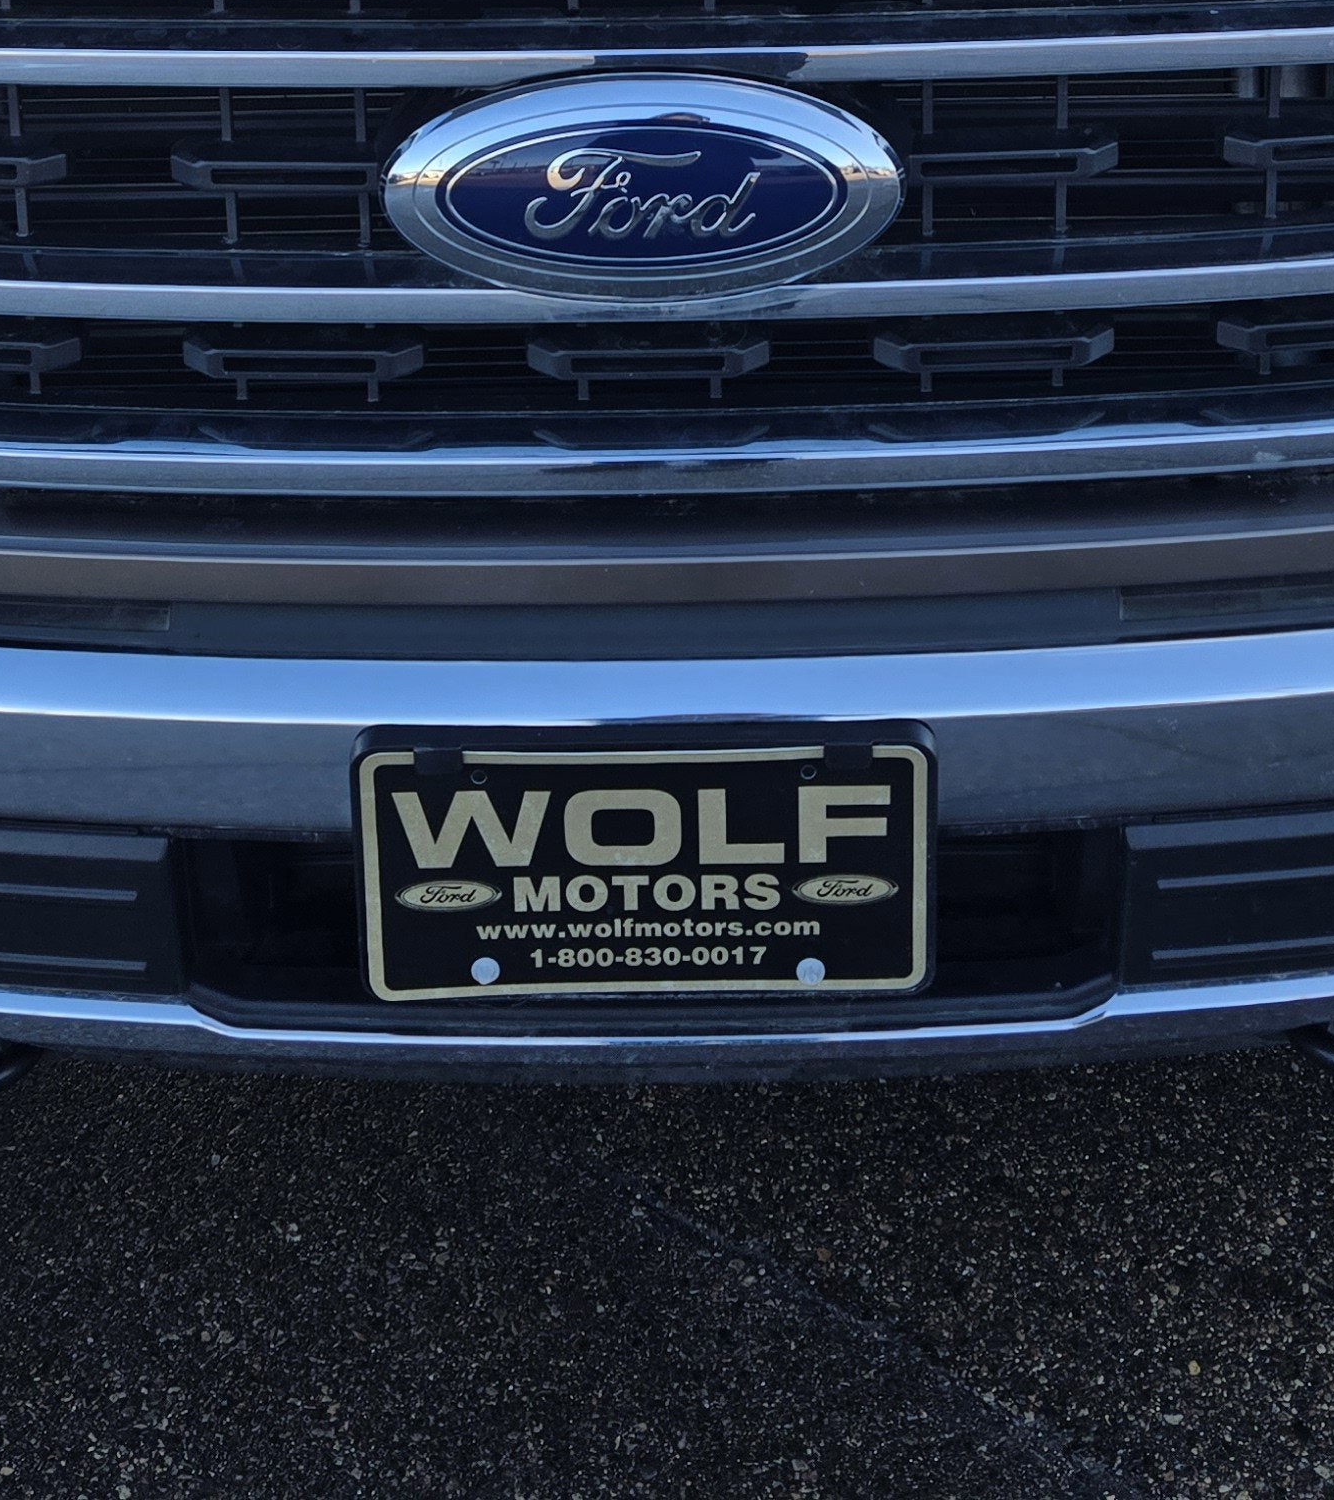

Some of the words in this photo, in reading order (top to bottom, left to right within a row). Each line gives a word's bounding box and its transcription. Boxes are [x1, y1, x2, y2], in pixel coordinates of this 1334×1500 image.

[523, 146, 762, 240] Ford
[390, 785, 892, 869] WOLF
[418, 884, 477, 905] Ford
[512, 874, 782, 913] MOTORS
[814, 877, 873, 899] Ford
[476, 917, 821, 941] www.wolfmotors.com
[529, 946, 767, 969] 1-800-830-0017
